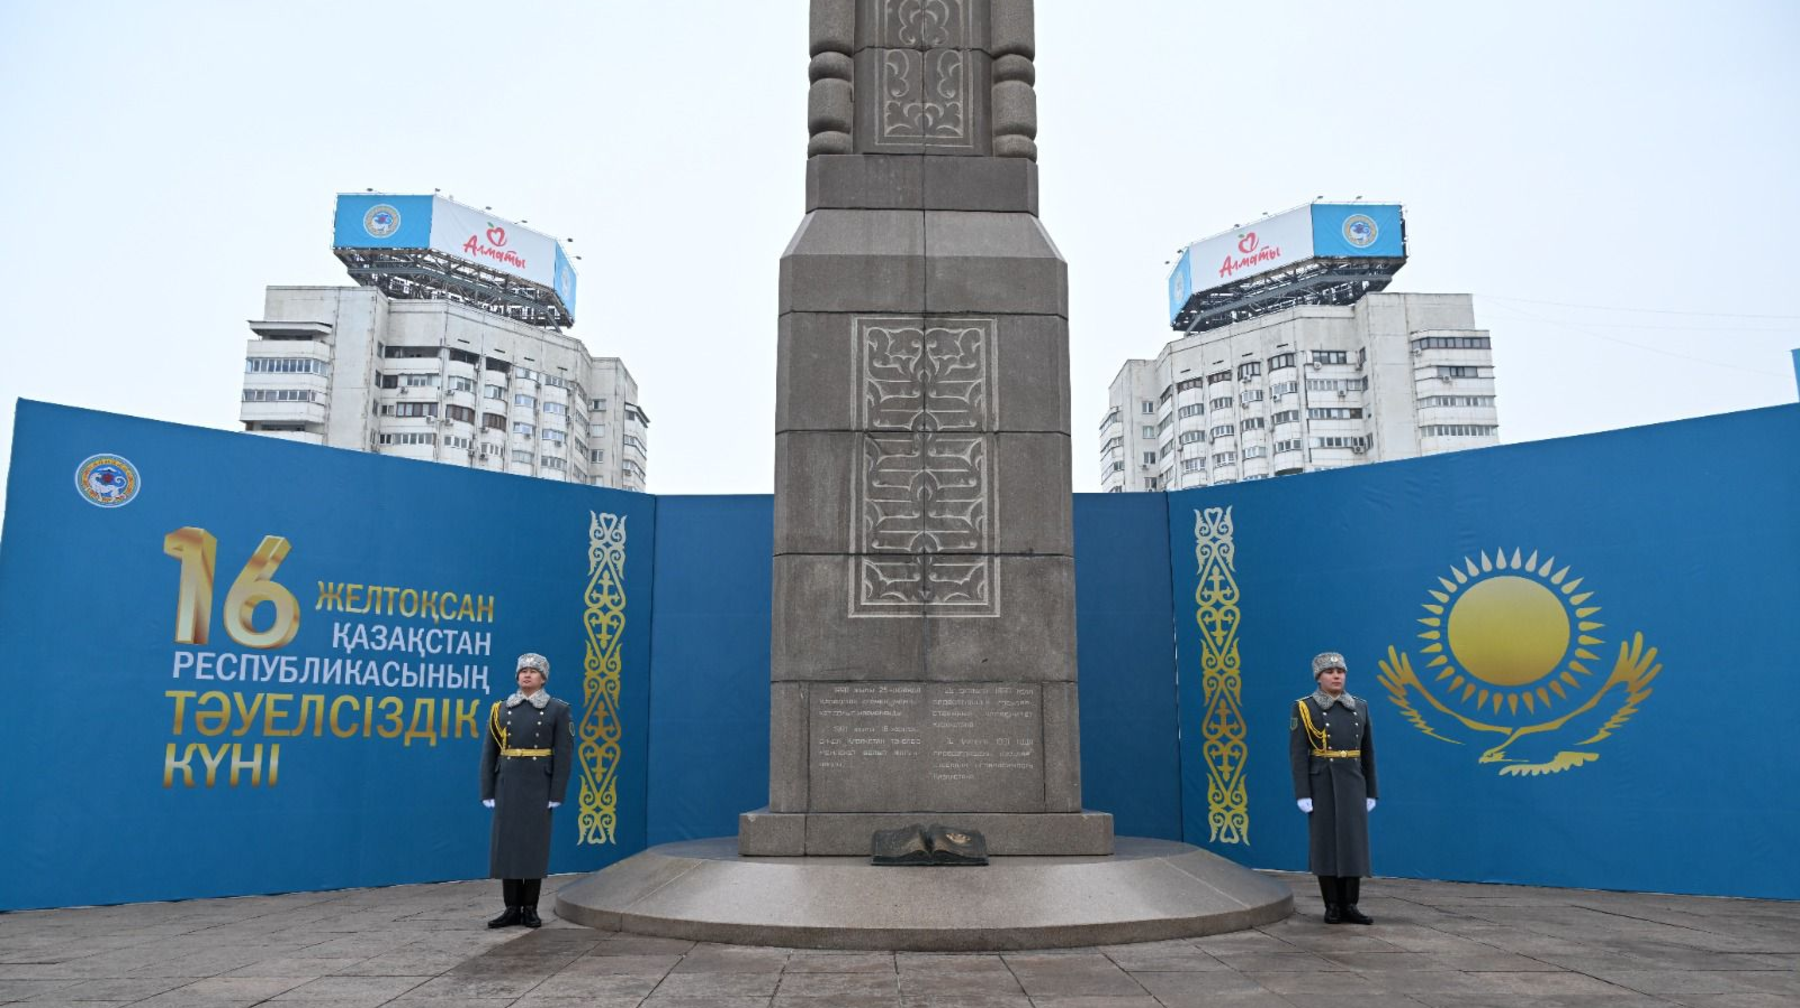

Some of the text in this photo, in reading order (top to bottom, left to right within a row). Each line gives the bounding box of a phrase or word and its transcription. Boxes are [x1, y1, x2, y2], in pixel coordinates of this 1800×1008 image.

[463, 235, 526, 269] Алматы
[1219, 246, 1282, 278] Алматы
[163, 526, 495, 649] 16 ЖЕЛТОҚСАН
[332, 622, 491, 656] ҚАЗАҚСТАН
[172, 651, 490, 695] РЕСПУБЛИКАСЫНЫҢ
[165, 690, 480, 747] ТӘУЕЛСІЗДІК
[163, 743, 280, 789] КҮНІ
